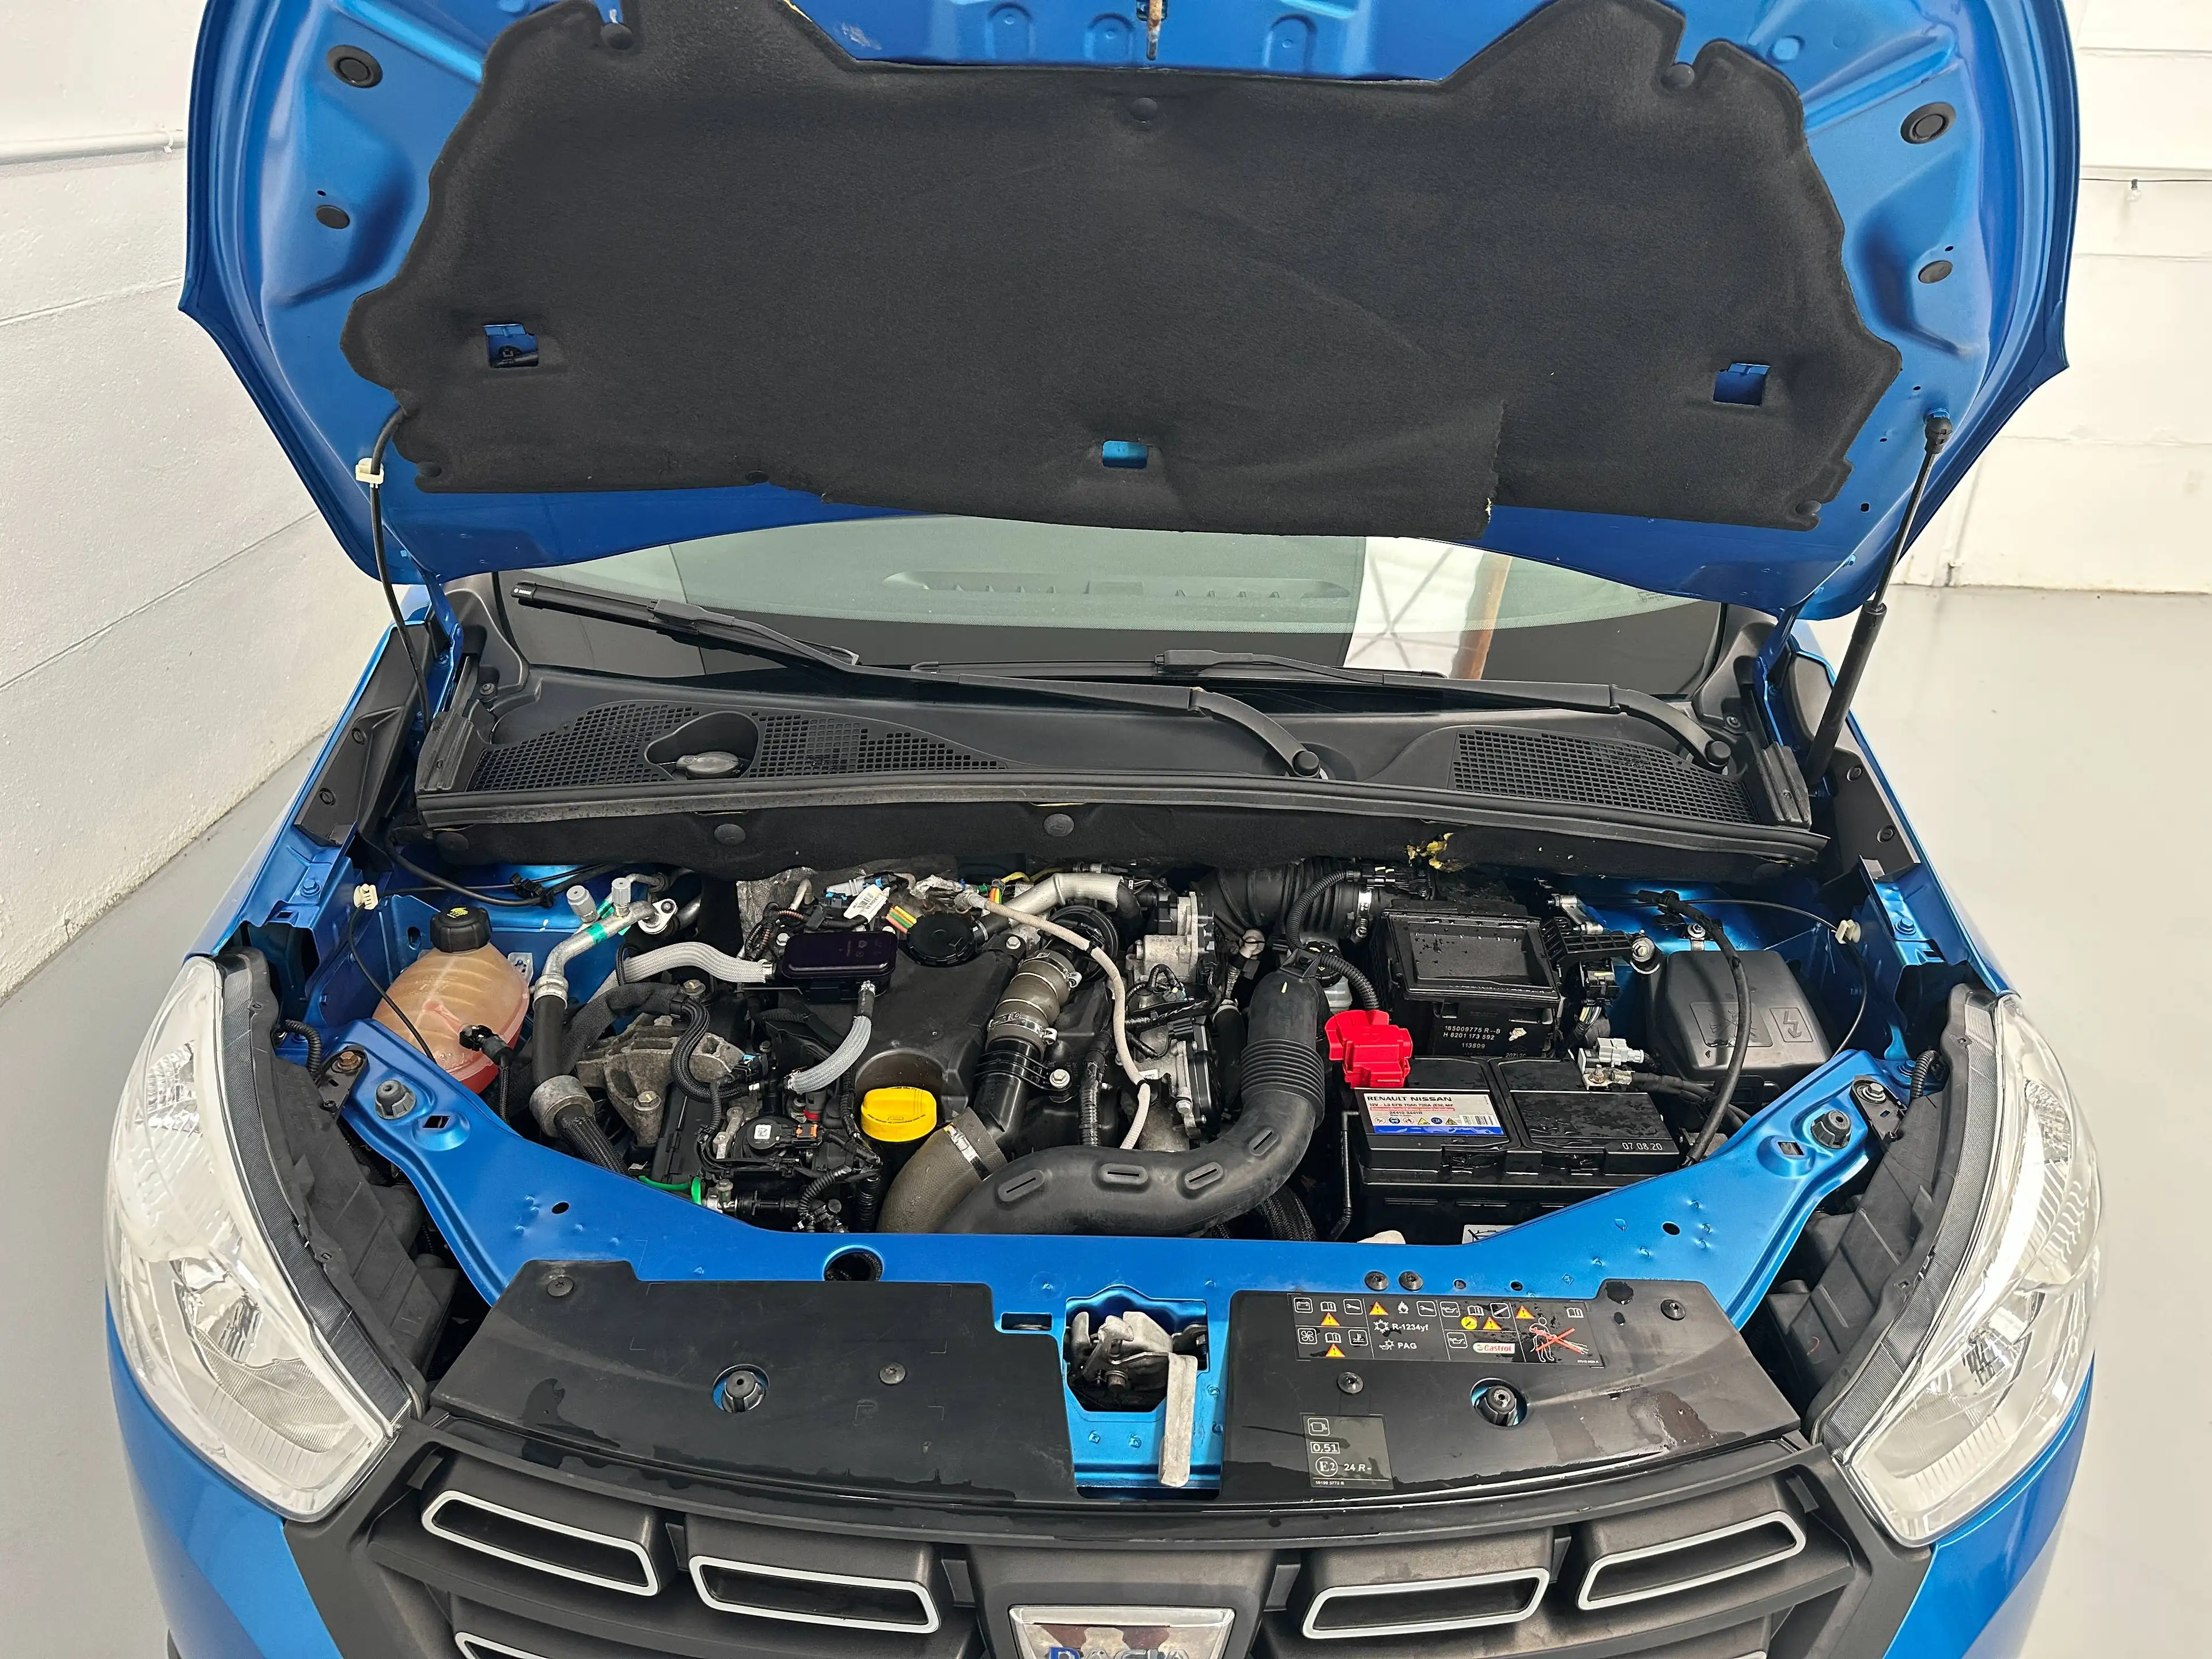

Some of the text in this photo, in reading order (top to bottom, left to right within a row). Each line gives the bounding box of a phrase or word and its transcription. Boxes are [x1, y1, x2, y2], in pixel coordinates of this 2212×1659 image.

[1392, 1323, 1429, 1332] R-1234yf
[1484, 1344, 1512, 1352] Castrol
[1313, 1443, 1338, 1452] 0,51
[1343, 1463, 1356, 1471] 24
